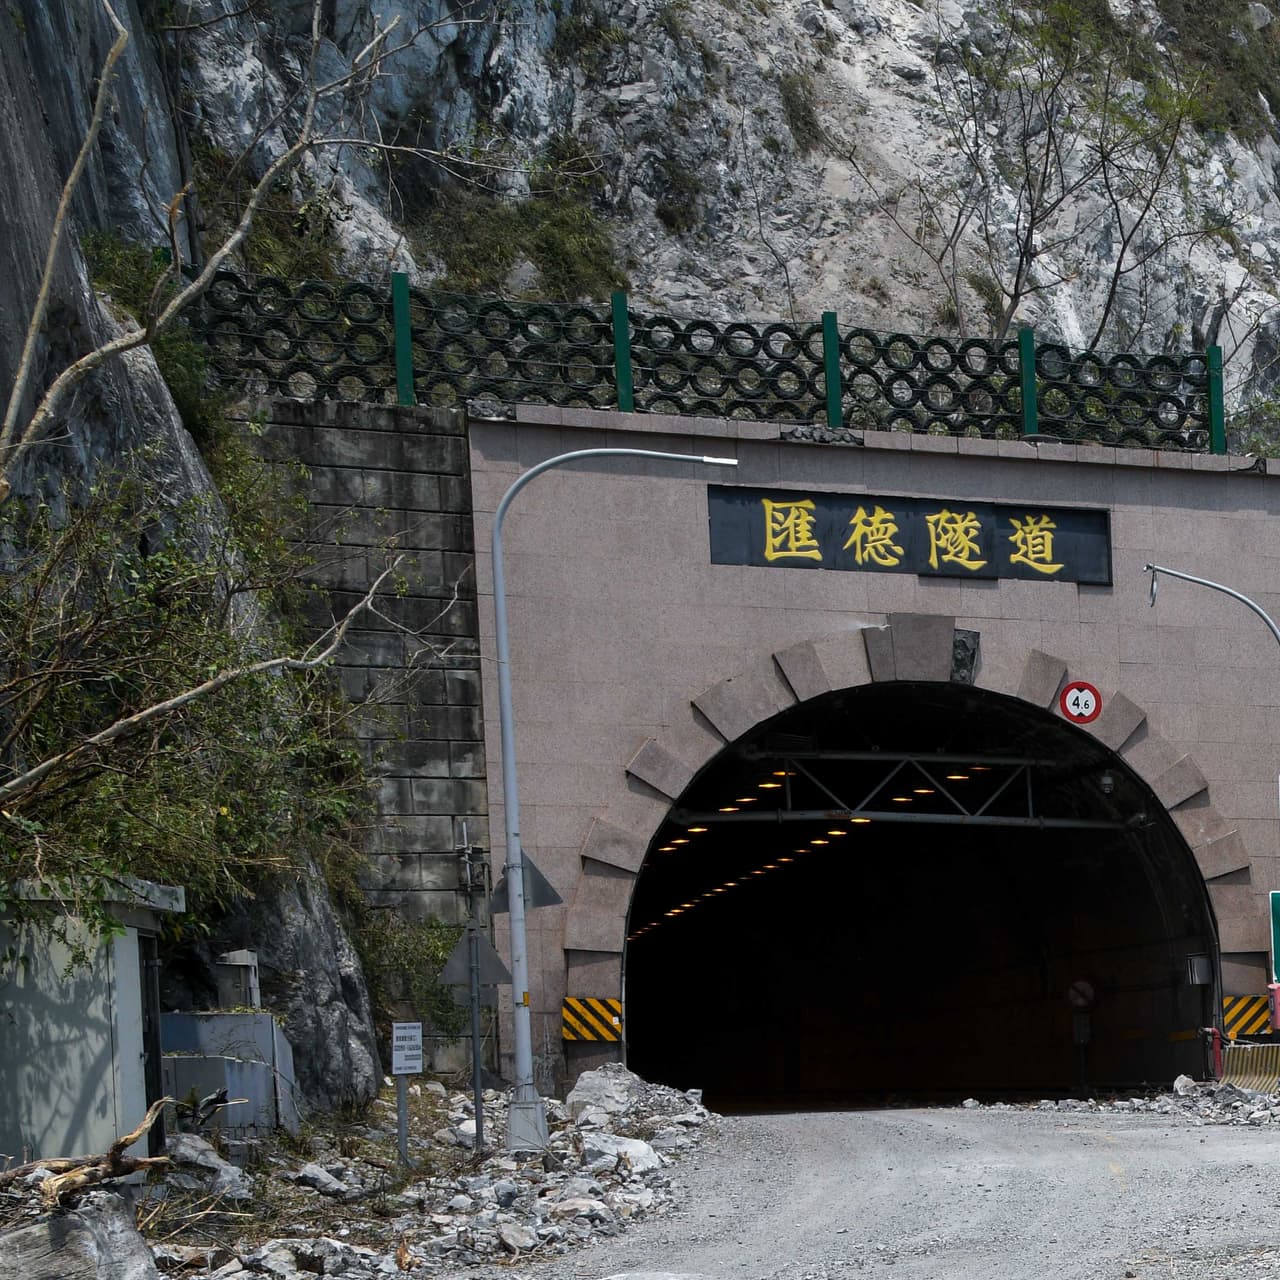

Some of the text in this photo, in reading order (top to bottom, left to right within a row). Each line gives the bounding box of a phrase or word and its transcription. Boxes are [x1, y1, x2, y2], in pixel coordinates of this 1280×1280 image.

[760, 497, 1066, 575] 匯德隧道
[1072, 695, 1090, 710] 4.6
